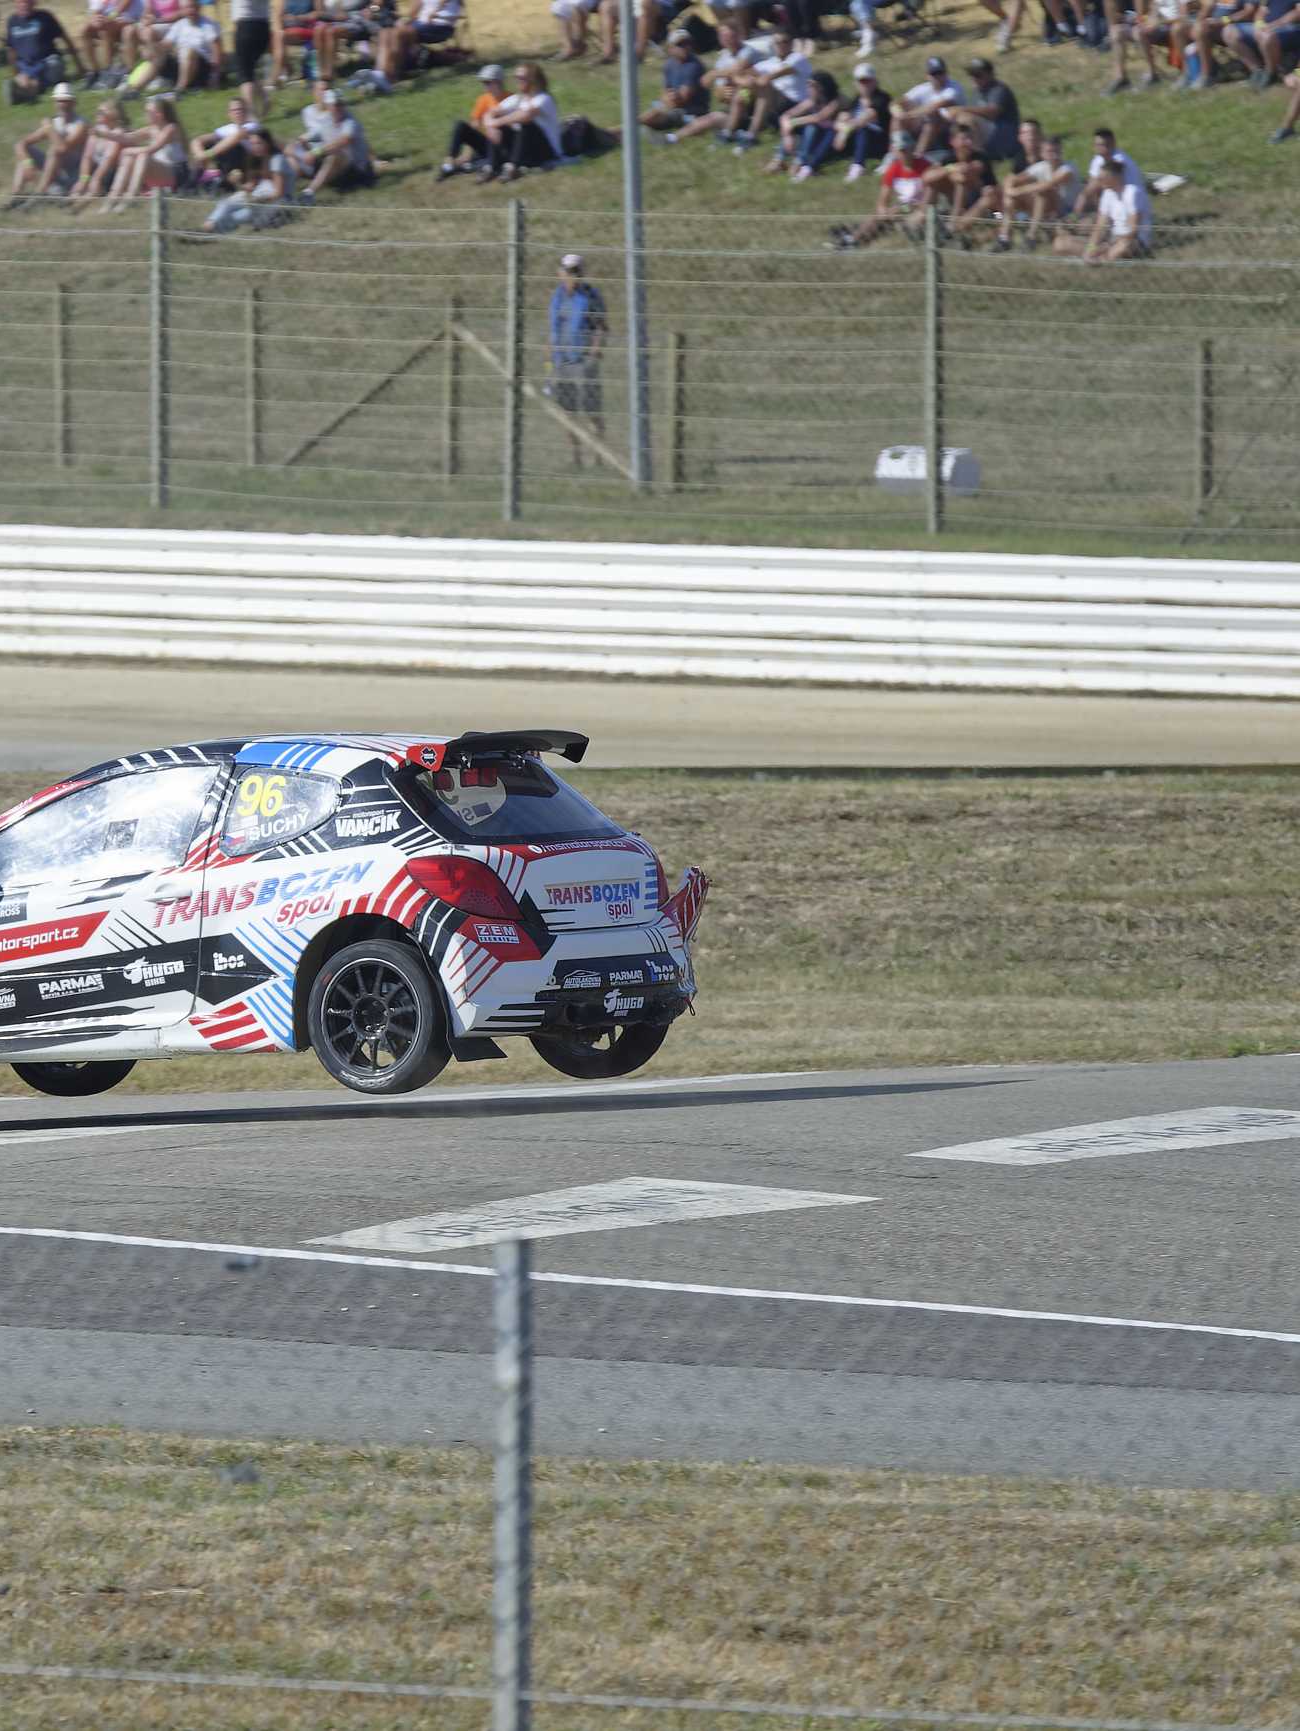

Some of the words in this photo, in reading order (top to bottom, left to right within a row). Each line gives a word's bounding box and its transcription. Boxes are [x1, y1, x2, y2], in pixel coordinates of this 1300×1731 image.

[236, 775, 287, 817] 96
[546, 880, 640, 905] TRANSBOZEN
[608, 899, 632, 918] spol
[477, 925, 516, 936] ZEM
[142, 960, 185, 981] HUGO
[38, 974, 99, 994] PARMA
[616, 997, 645, 1010] HUGO
